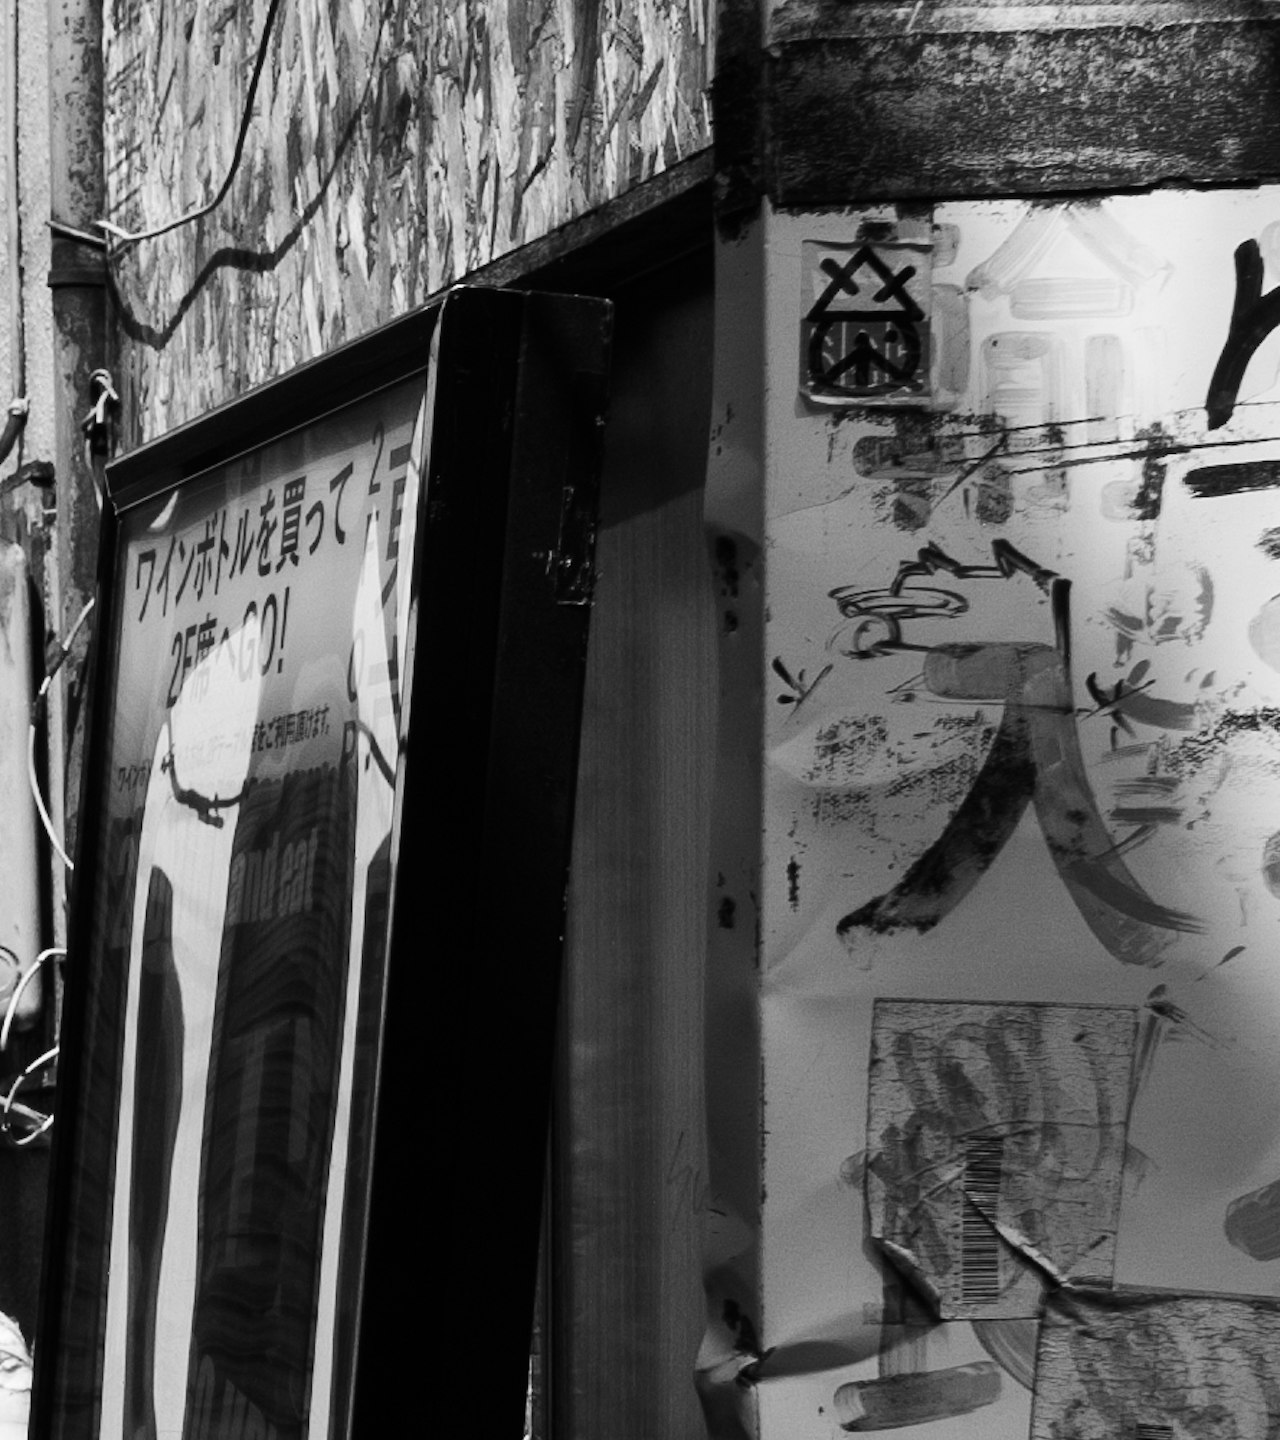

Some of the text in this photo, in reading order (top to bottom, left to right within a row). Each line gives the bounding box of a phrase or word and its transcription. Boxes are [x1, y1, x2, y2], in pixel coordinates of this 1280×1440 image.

[135, 460, 354, 623] ワインボトルを買って
[168, 586, 291, 709] 2F席へGO!
